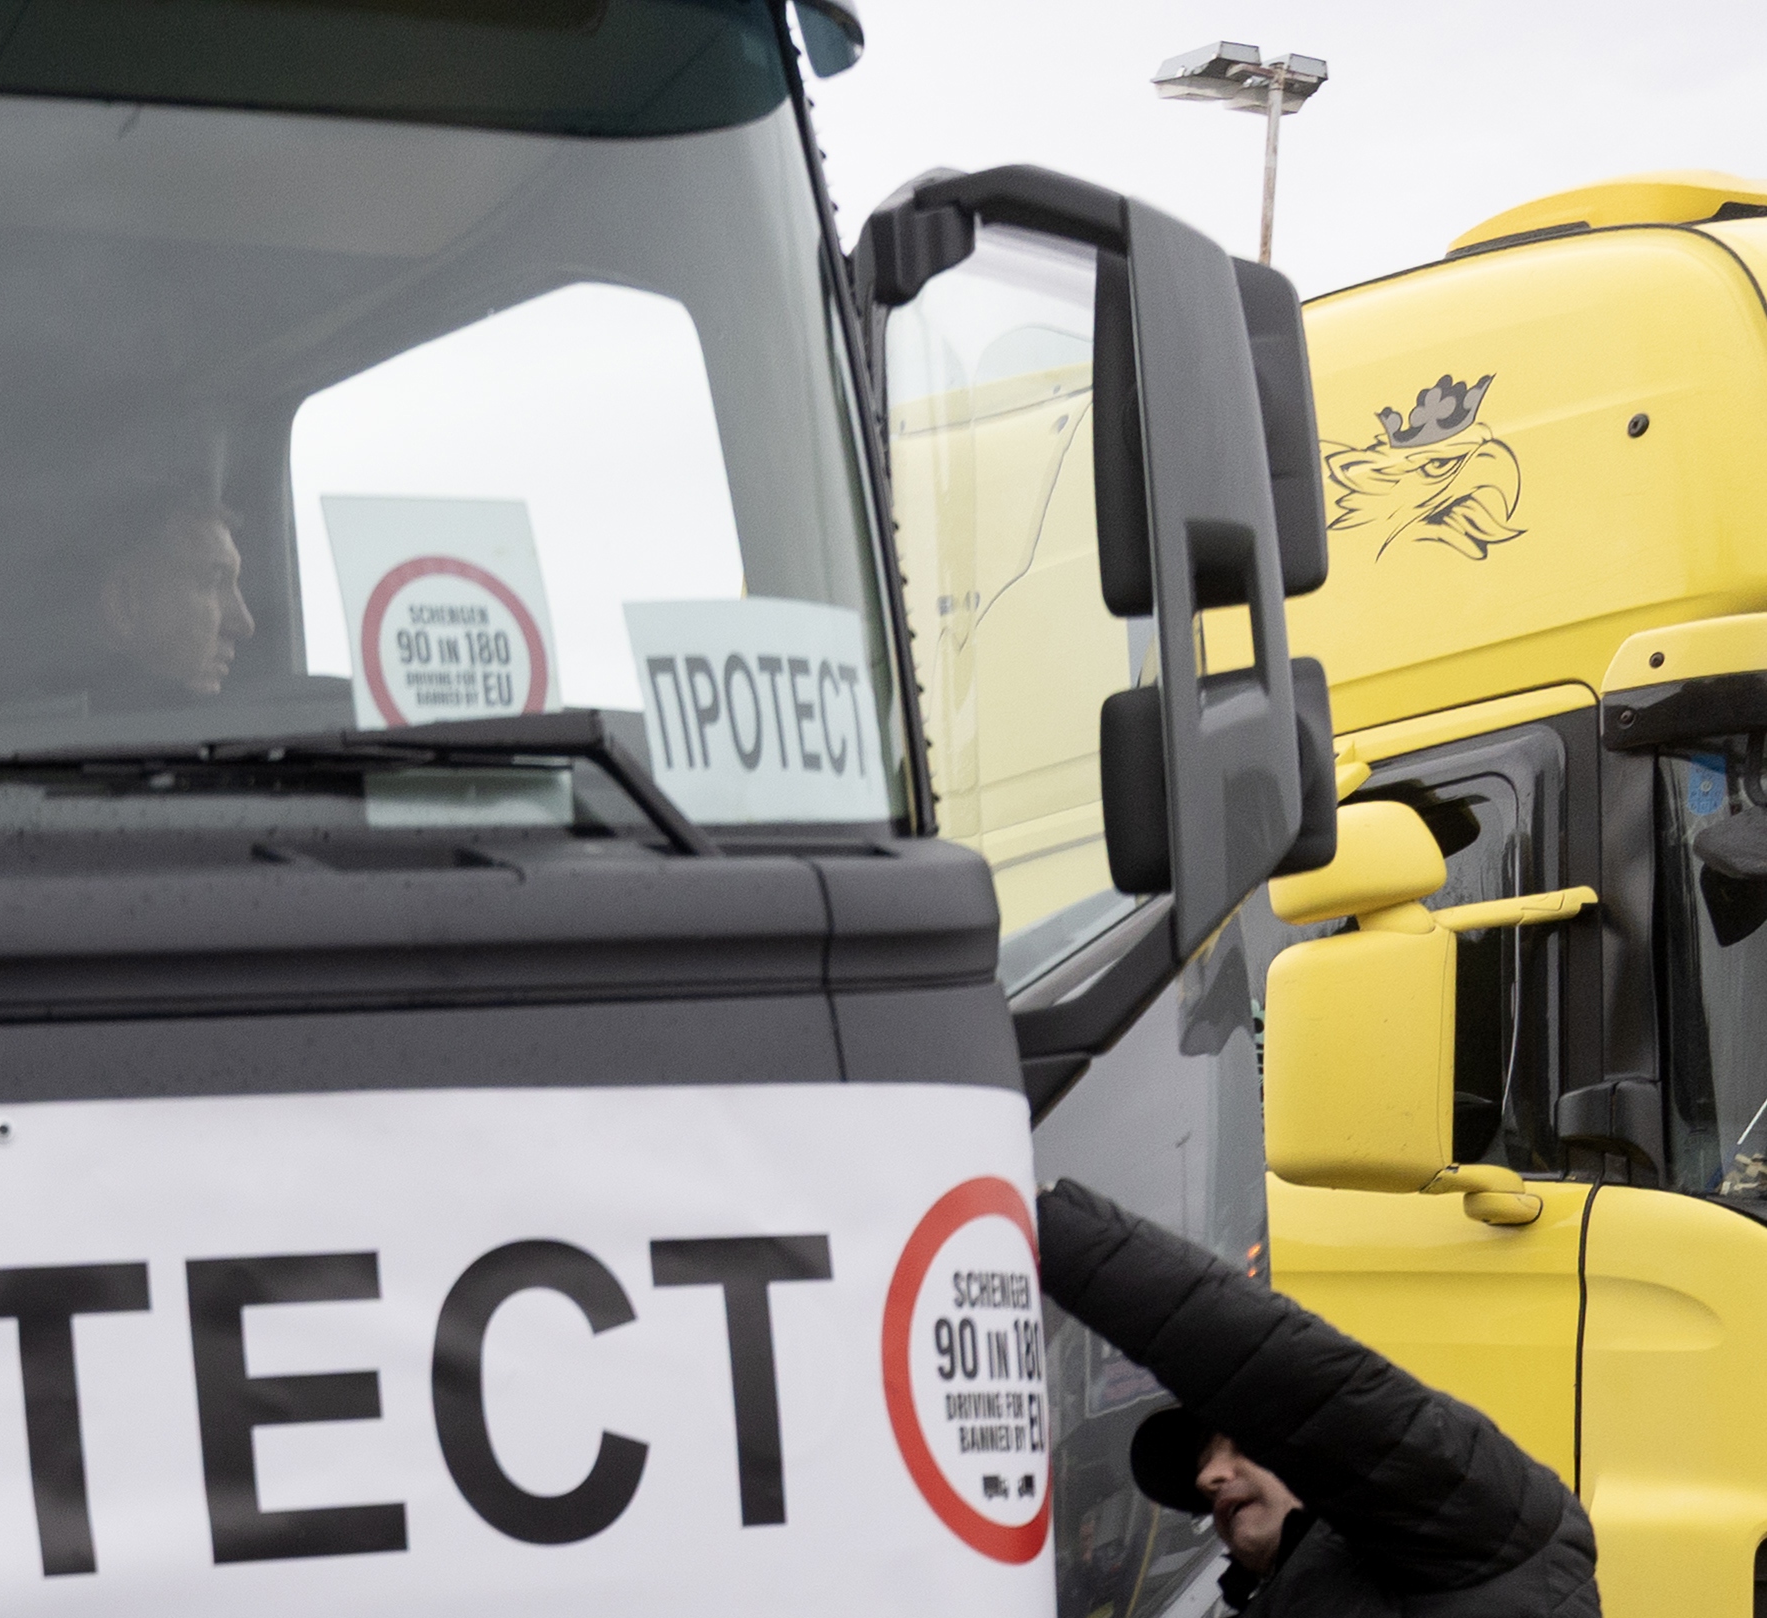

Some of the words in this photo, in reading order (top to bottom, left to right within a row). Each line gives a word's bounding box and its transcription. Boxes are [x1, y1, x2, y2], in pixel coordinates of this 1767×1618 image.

[397, 629, 431, 665] 90
[438, 638, 460, 664] IN
[465, 630, 510, 665] 180
[483, 672, 513, 706] EU
[646, 653, 866, 779] ПРОТЕСТ
[934, 1318, 978, 1381] 90
[988, 1331, 1009, 1381] IN
